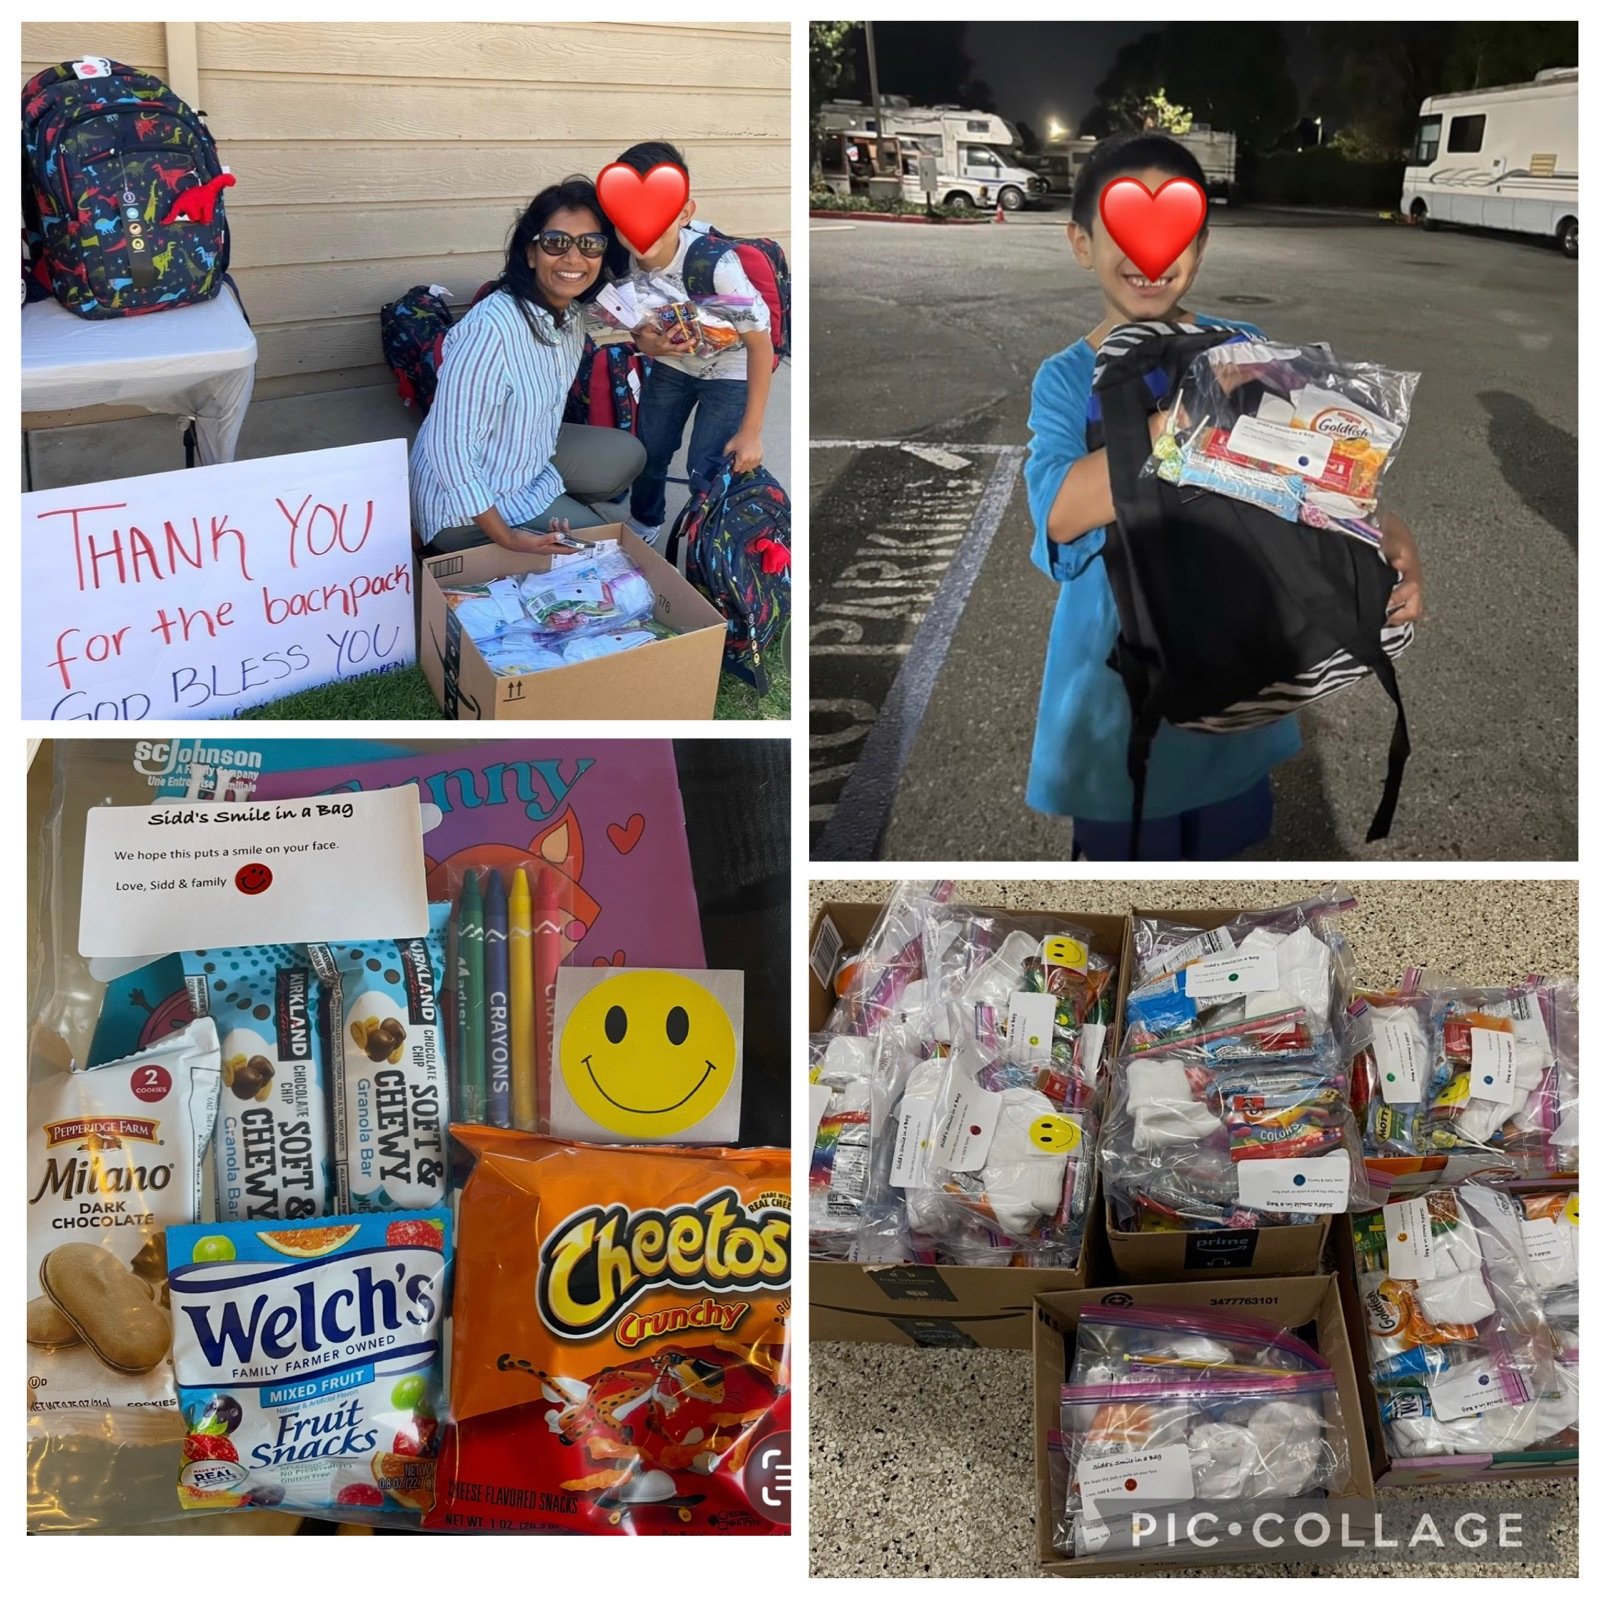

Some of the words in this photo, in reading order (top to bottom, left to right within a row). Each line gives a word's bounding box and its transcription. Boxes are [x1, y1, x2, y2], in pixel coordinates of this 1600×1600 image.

[1318, 418, 1368, 437] Goldfish
[37, 503, 254, 591] THANK
[275, 494, 373, 569] YOU
[47, 626, 132, 690] for
[151, 602, 235, 645] the
[262, 563, 411, 626] backpack
[171, 644, 310, 708] BLESS
[325, 624, 400, 675] YOU
[148, 811, 209, 826] Sidd's
[214, 808, 271, 824] Smile
[276, 806, 298, 820] in
[302, 806, 312, 818] a
[316, 803, 354, 818] Bag
[114, 850, 134, 861] We
[138, 850, 167, 862] hope
[170, 848, 191, 860] this
[194, 848, 220, 861] puts
[222, 848, 229, 857] a
[232, 845, 262, 856] smile
[266, 846, 280, 854] on
[283, 843, 310, 856] your
[312, 841, 340, 852] face.
[116, 881, 146, 892] Love,
[150, 880, 175, 890] Sidd
[178, 880, 188, 890] &
[191, 877, 227, 889] family
[410, 939, 435, 1021] KIRKLAND
[288, 973, 308, 1056] KIRKLAND
[412, 1045, 425, 1068] CHIP
[424, 1029, 437, 1081] CHOCOLATE
[490, 991, 510, 1093] CRAYONS
[144, 1070, 158, 1085] 2
[281, 1082, 294, 1104] CHIP
[294, 1065, 309, 1118] CHOCOLATE
[357, 1078, 374, 1143] Granola
[374, 1070, 411, 1184] CHEWY
[410, 1084, 442, 1152] SOFT
[54, 1121, 116, 1140] PEPPERIDGE
[120, 1120, 149, 1136] FARM
[224, 1116, 240, 1182] Granola
[241, 1108, 278, 1220] CHEWY
[278, 1121, 314, 1191] SOFT
[360, 1148, 374, 1178] Bar
[29, 1157, 172, 1204] Milano
[417, 1158, 444, 1188] &
[80, 1201, 126, 1214] DARK
[228, 1188, 240, 1218] Bar
[285, 1196, 316, 1220] &
[748, 1200, 770, 1214] REAL
[52, 1213, 154, 1229] CHOCOLATE
[1196, 1236, 1248, 1248] prime
[548, 1197, 790, 1327] Cheetos
[181, 1262, 438, 1368] Welch's
[1210, 1297, 1279, 1306] 3477763101
[1364, 1287, 1396, 1330] Goldfish
[618, 1301, 745, 1344] Crunchy
[232, 1364, 279, 1379] FAMILY
[285, 1350, 340, 1374] FARMER
[345, 1334, 396, 1356] OWNED
[127, 1398, 176, 1408] COOKIES
[270, 1380, 316, 1403] MIXED
[322, 1370, 364, 1392] FRUIT
[273, 1399, 364, 1448] Fruit
[276, 1404, 300, 1414] Natural
[249, 1429, 378, 1470] Snacks
[194, 1470, 233, 1482] REAL
[448, 1480, 482, 1502] CHEESE
[486, 1485, 536, 1510] FLAVORED
[540, 1492, 578, 1514] SNACKS
[445, 1514, 464, 1526] NET
[467, 1516, 482, 1528] WT
[490, 1518, 494, 1529] 1
